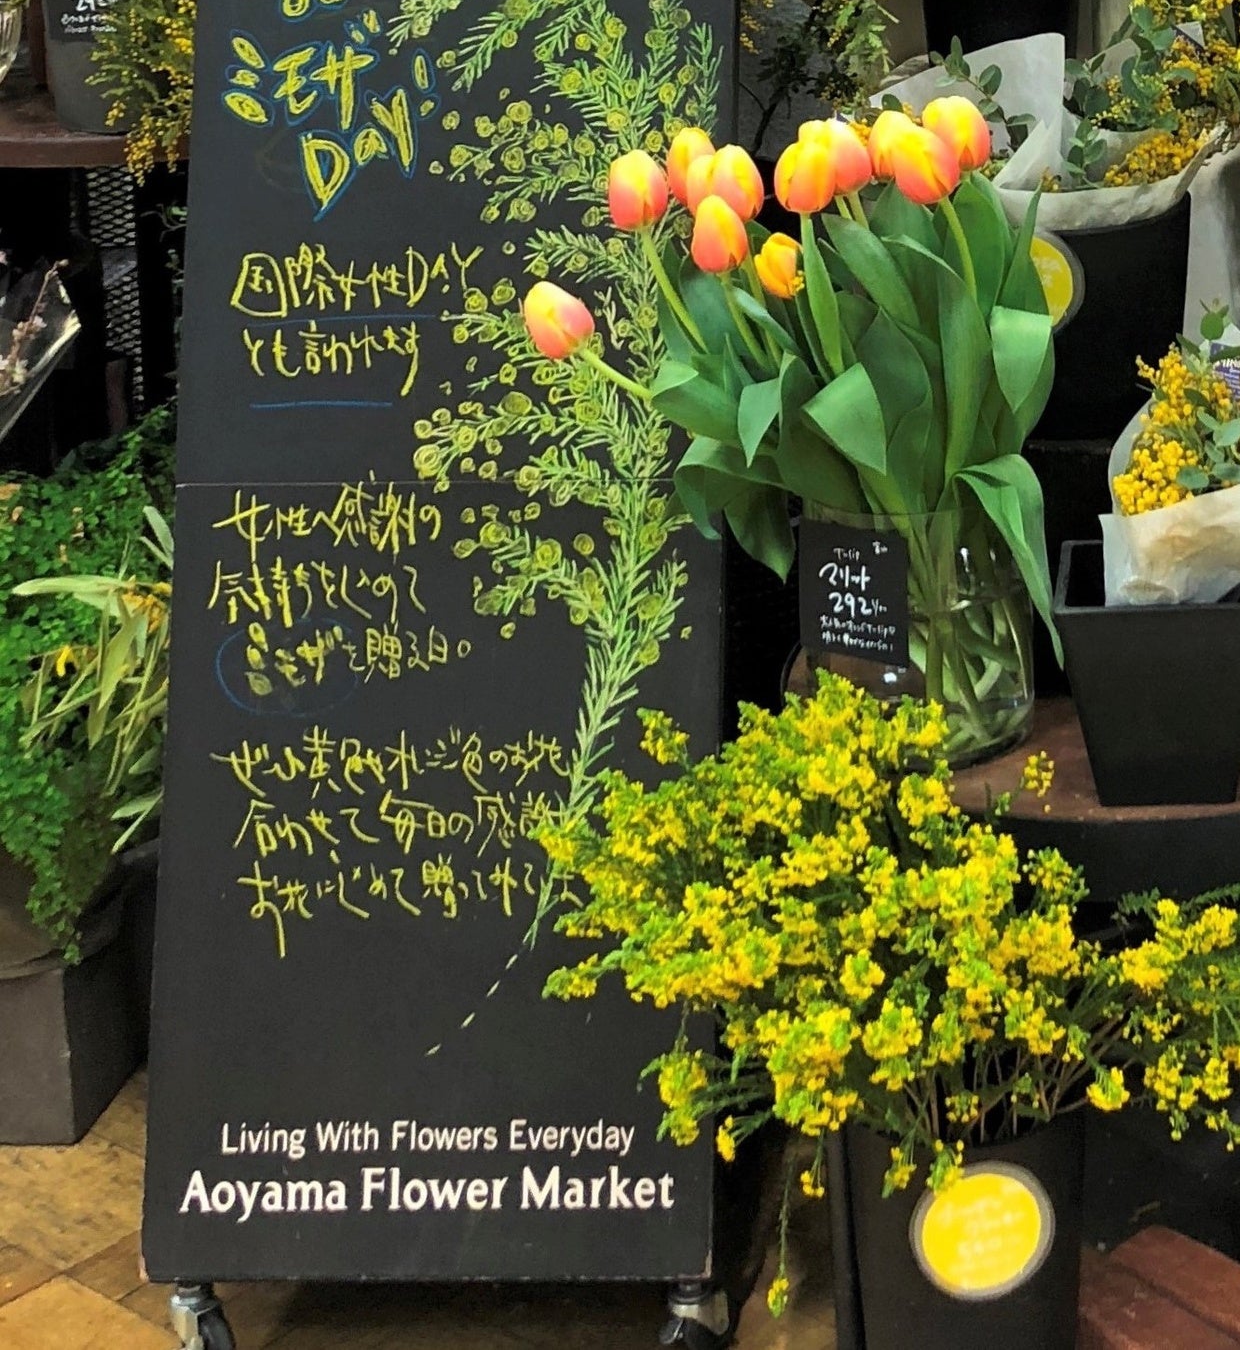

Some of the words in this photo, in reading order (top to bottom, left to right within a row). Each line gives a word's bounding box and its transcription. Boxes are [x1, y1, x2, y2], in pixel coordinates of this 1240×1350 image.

[220, 1122, 306, 1159] Living
[316, 1120, 380, 1151] With
[391, 1120, 498, 1151] Flowers
[509, 1119, 635, 1155] Everyday
[179, 1169, 347, 1223] Aoyama
[360, 1166, 507, 1212] Flower
[519, 1166, 675, 1212] Market
